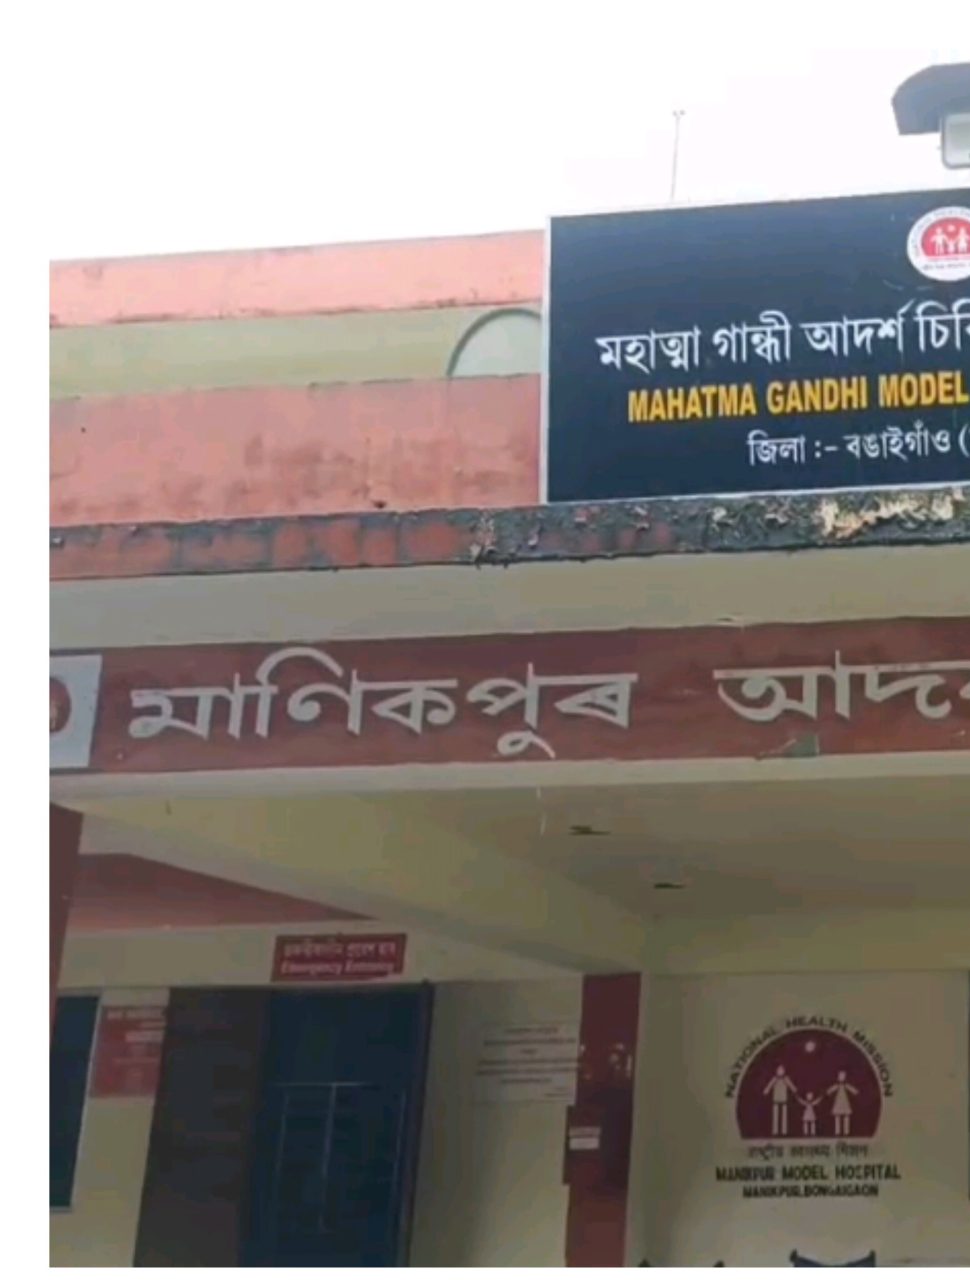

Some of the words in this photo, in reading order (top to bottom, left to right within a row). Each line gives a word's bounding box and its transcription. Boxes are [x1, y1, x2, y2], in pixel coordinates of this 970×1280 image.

[596, 324, 701, 374] মহাত্মা
[712, 310, 792, 365] গান্ধী
[628, 383, 757, 423] MAHATMA
[766, 376, 868, 415] GANDHI
[878, 370, 970, 408] MODEL
[129, 646, 639, 759] মাণিকপুৰ
[725, 1025, 778, 1098] NATIONAL
[786, 1016, 849, 1032] HEALTH
[853, 1030, 893, 1097] MISSION
[782, 1165, 828, 1181] MODEL
[835, 1163, 902, 1181] HOSPITAL
